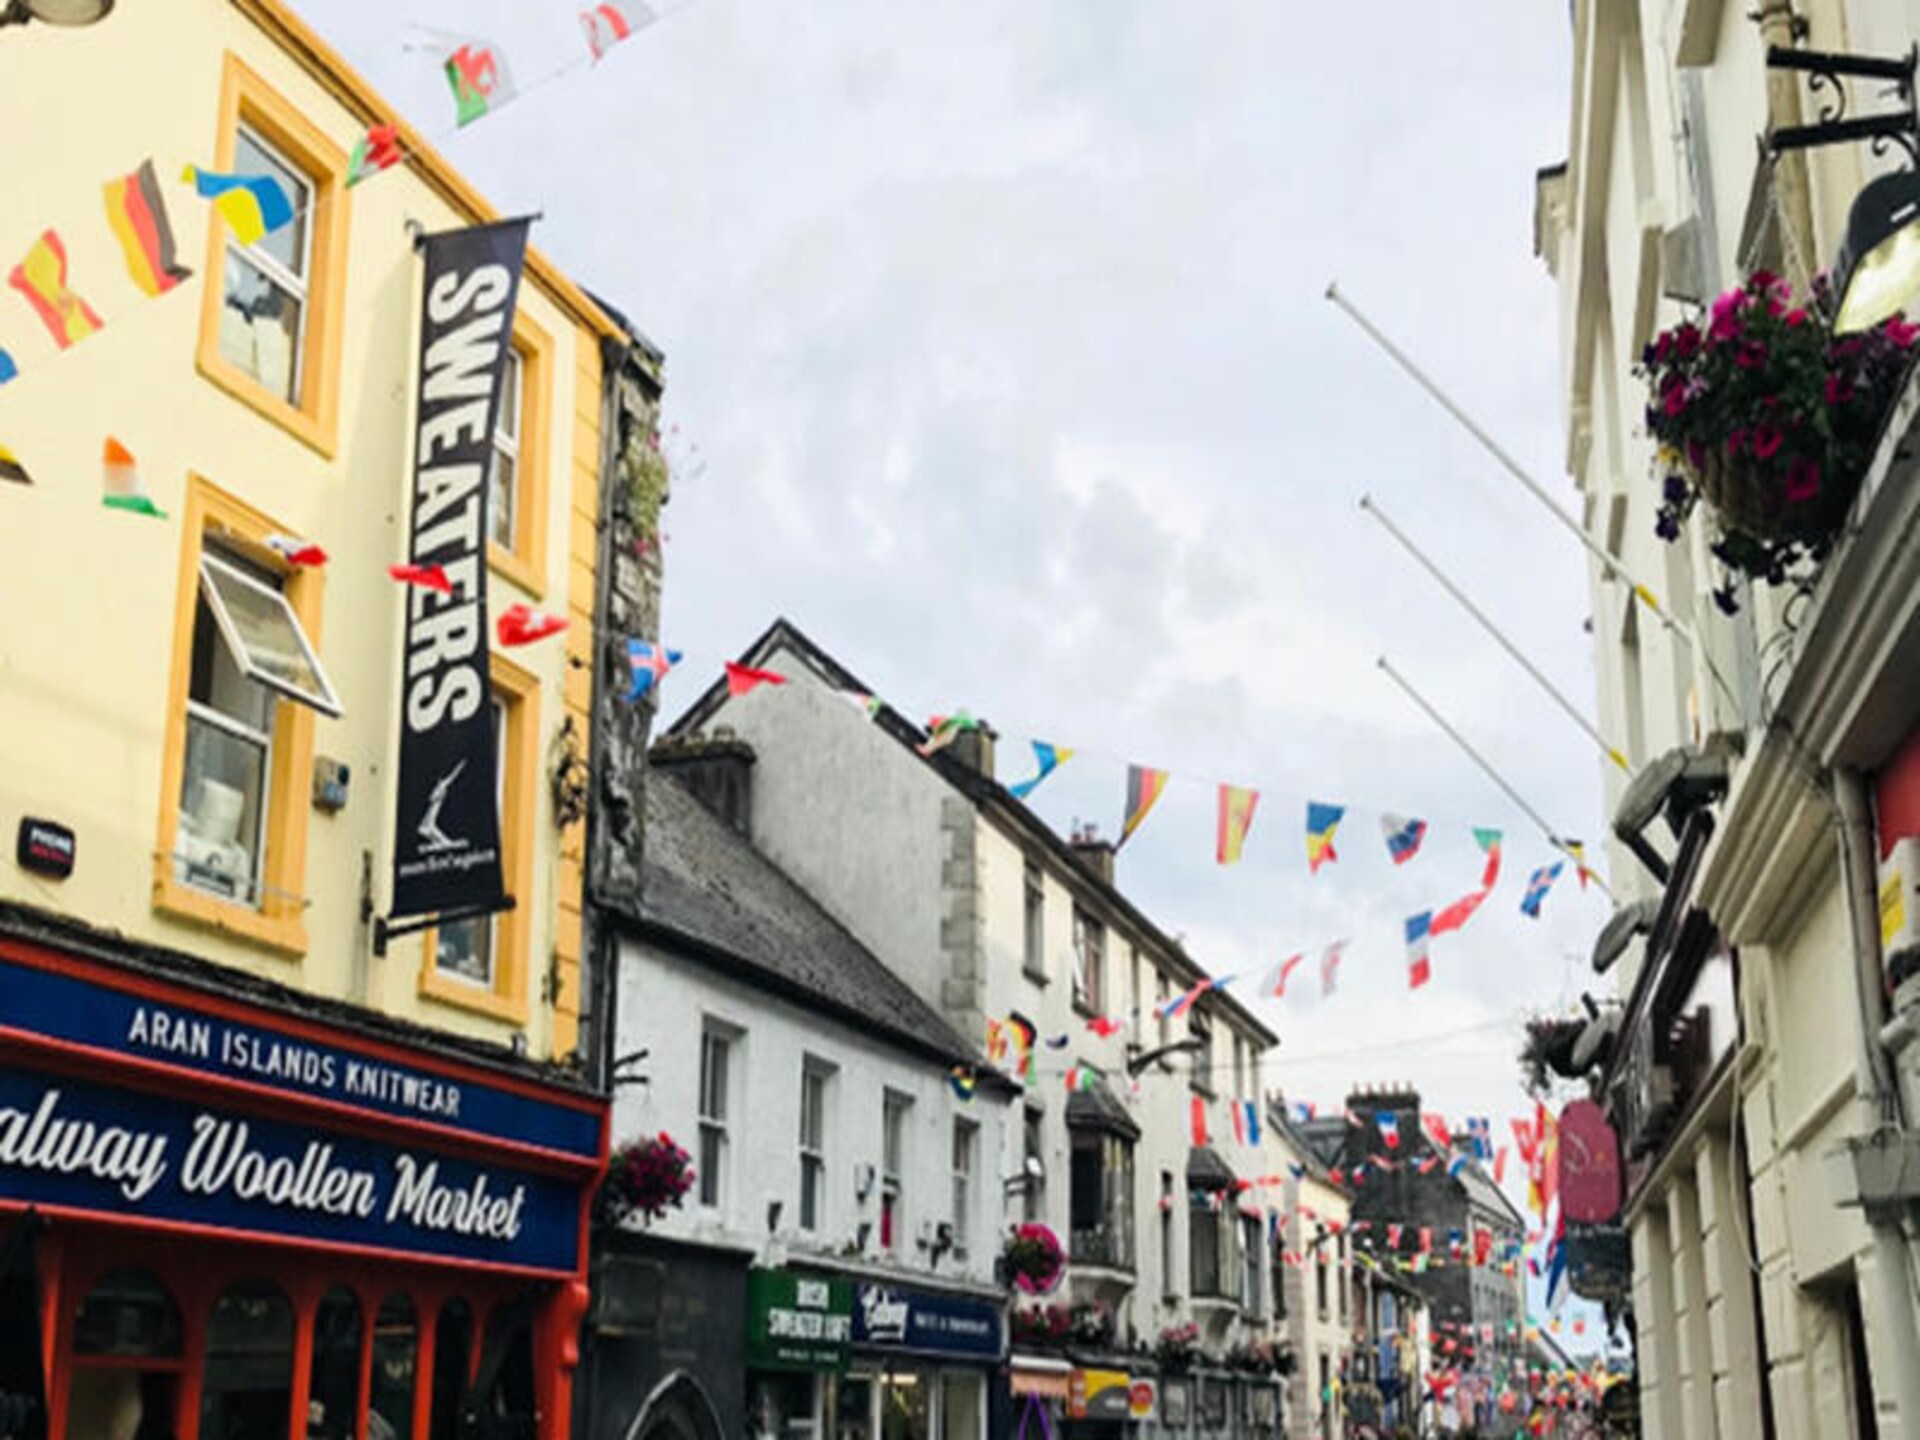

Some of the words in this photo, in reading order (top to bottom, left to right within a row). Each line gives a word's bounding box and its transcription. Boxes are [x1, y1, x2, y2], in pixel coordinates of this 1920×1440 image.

[408, 262, 512, 732] SWEATERS
[129, 1008, 210, 1057] ARAN
[222, 1031, 335, 1087] ISLANDS
[346, 1062, 460, 1117] KNITWEAR
[181, 1114, 376, 1217] Woollen
[386, 1154, 524, 1239] Market
